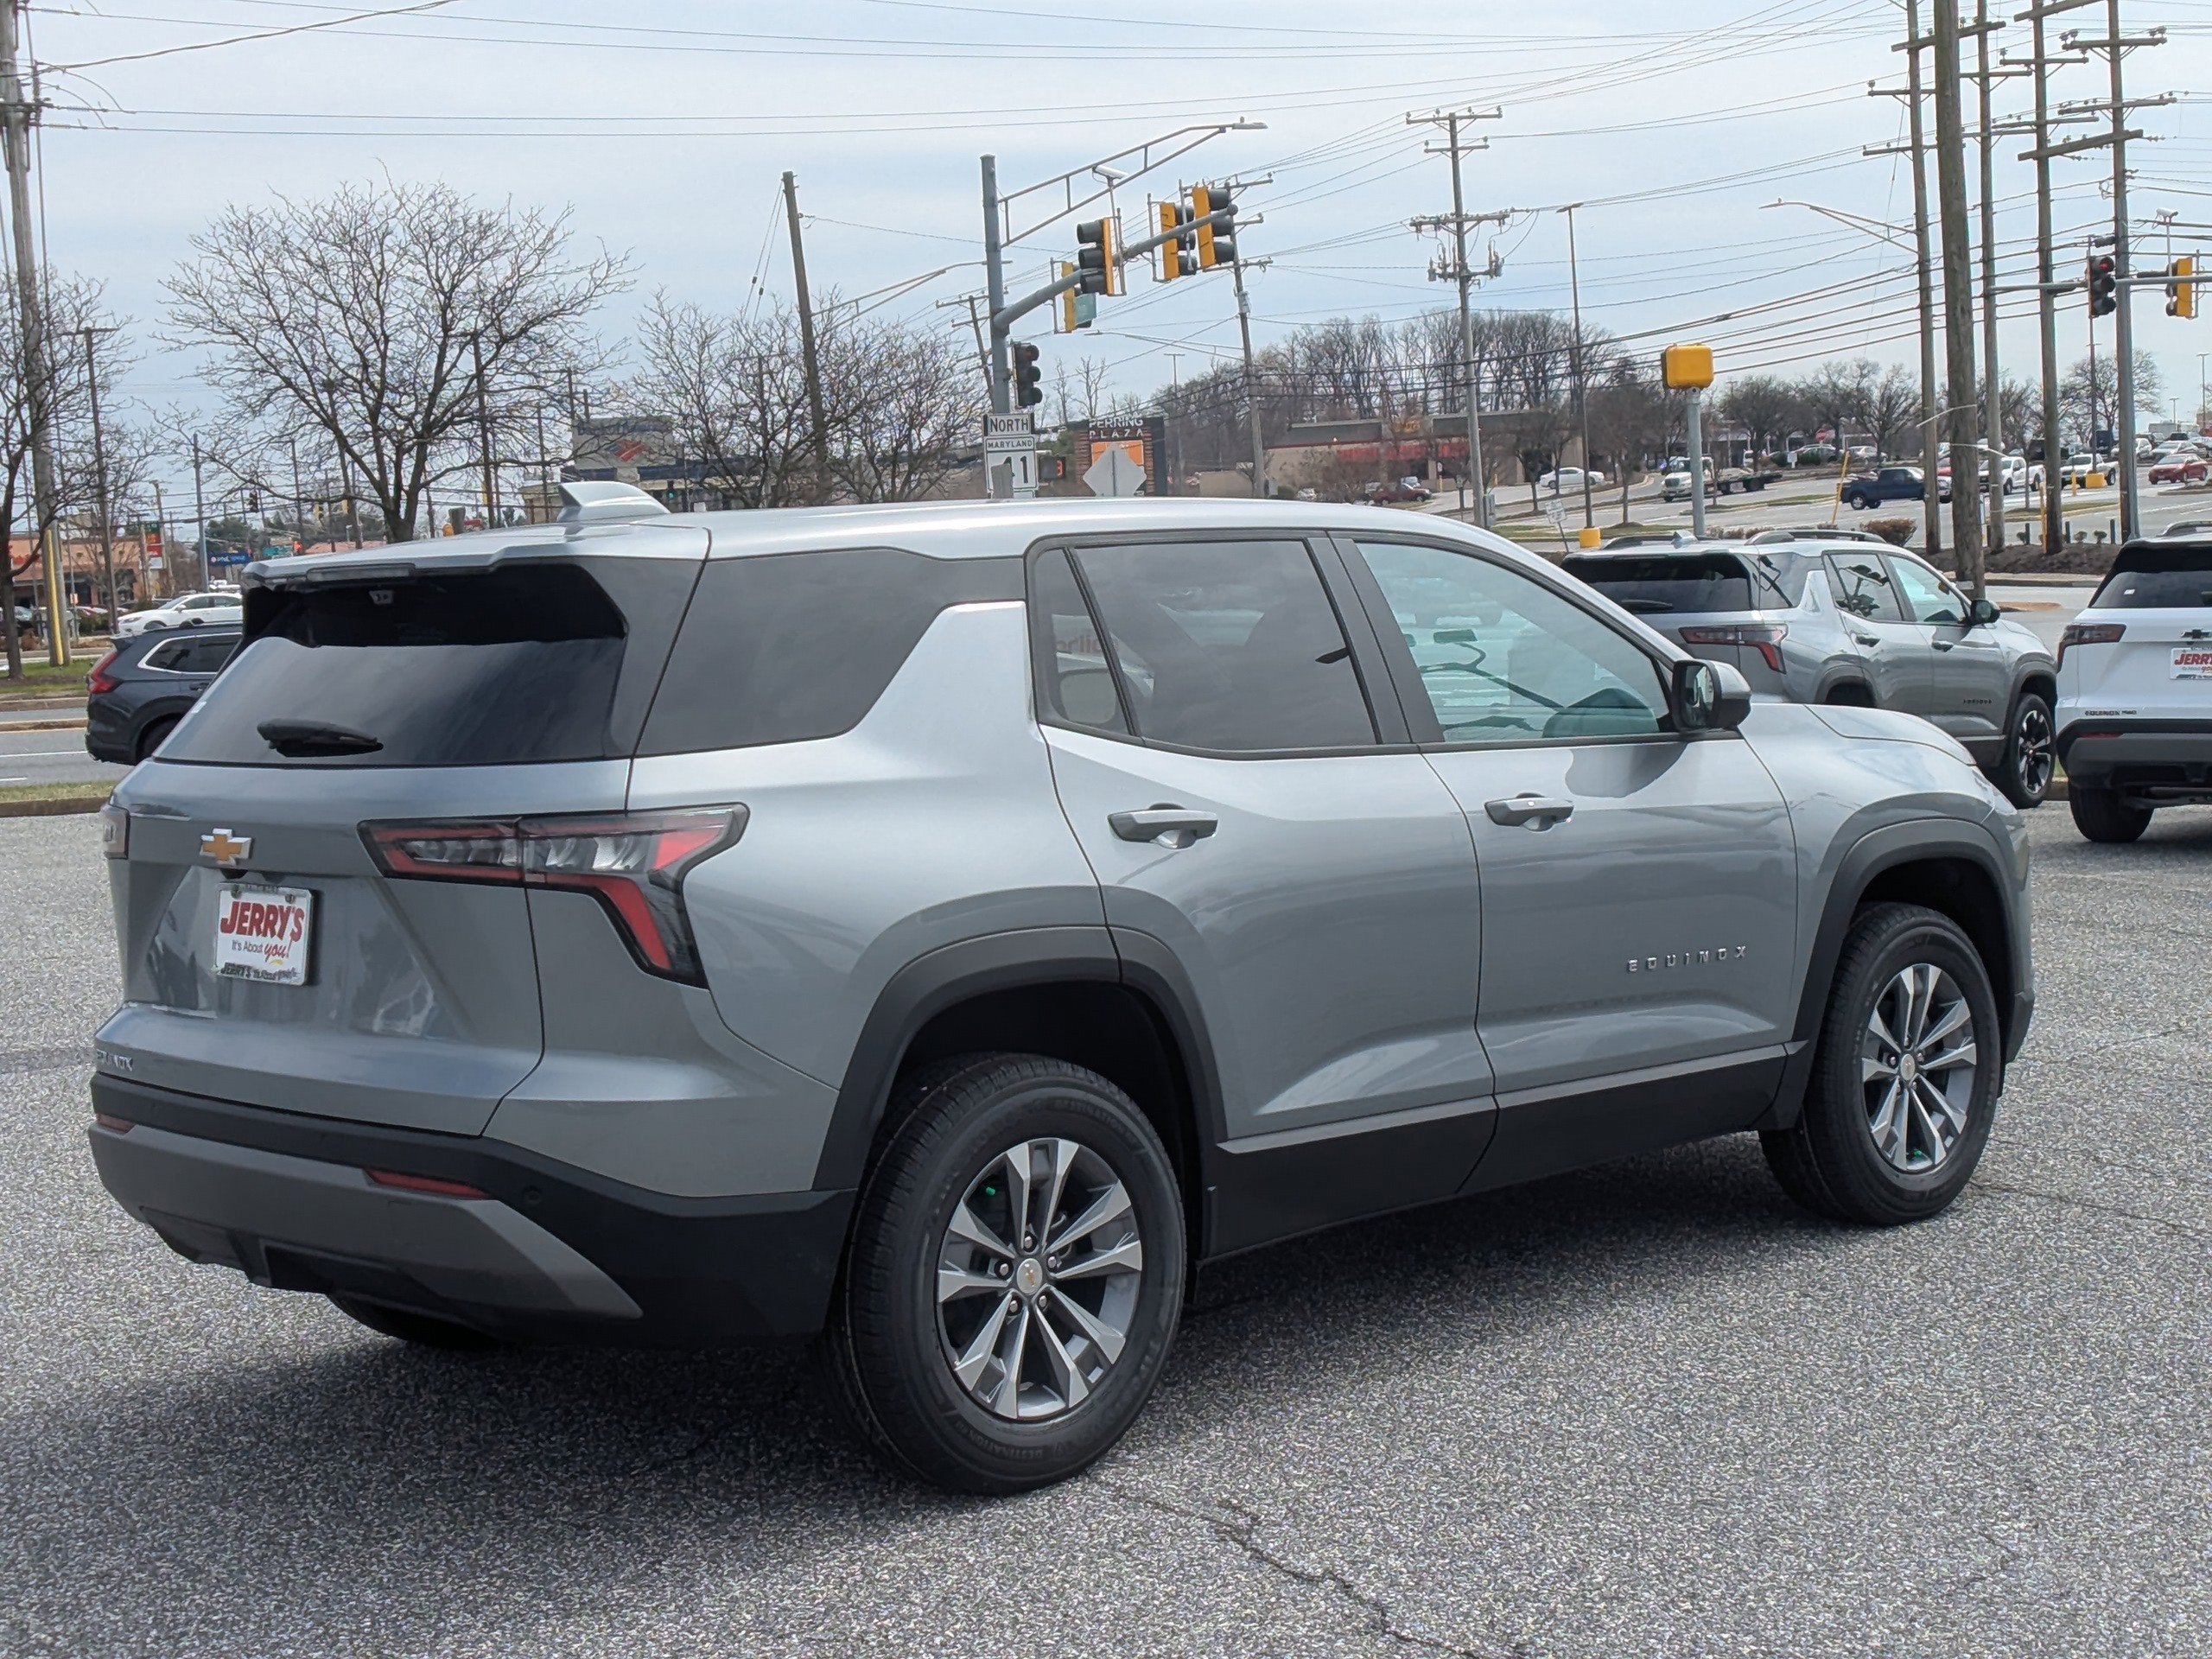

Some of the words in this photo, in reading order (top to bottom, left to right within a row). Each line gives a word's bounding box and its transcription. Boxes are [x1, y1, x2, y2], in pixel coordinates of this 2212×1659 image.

[990, 417, 1029, 432] NORTH
[1089, 416, 1144, 429] PERRING
[1089, 428, 1144, 440] PLAZA
[988, 439, 1033, 448] MARYLAND
[219, 900, 305, 942] JERRY'S
[232, 938, 242, 951] It's
[244, 940, 264, 954] About
[264, 939, 293, 963] you!
[1627, 945, 1747, 972] EQUINOX
